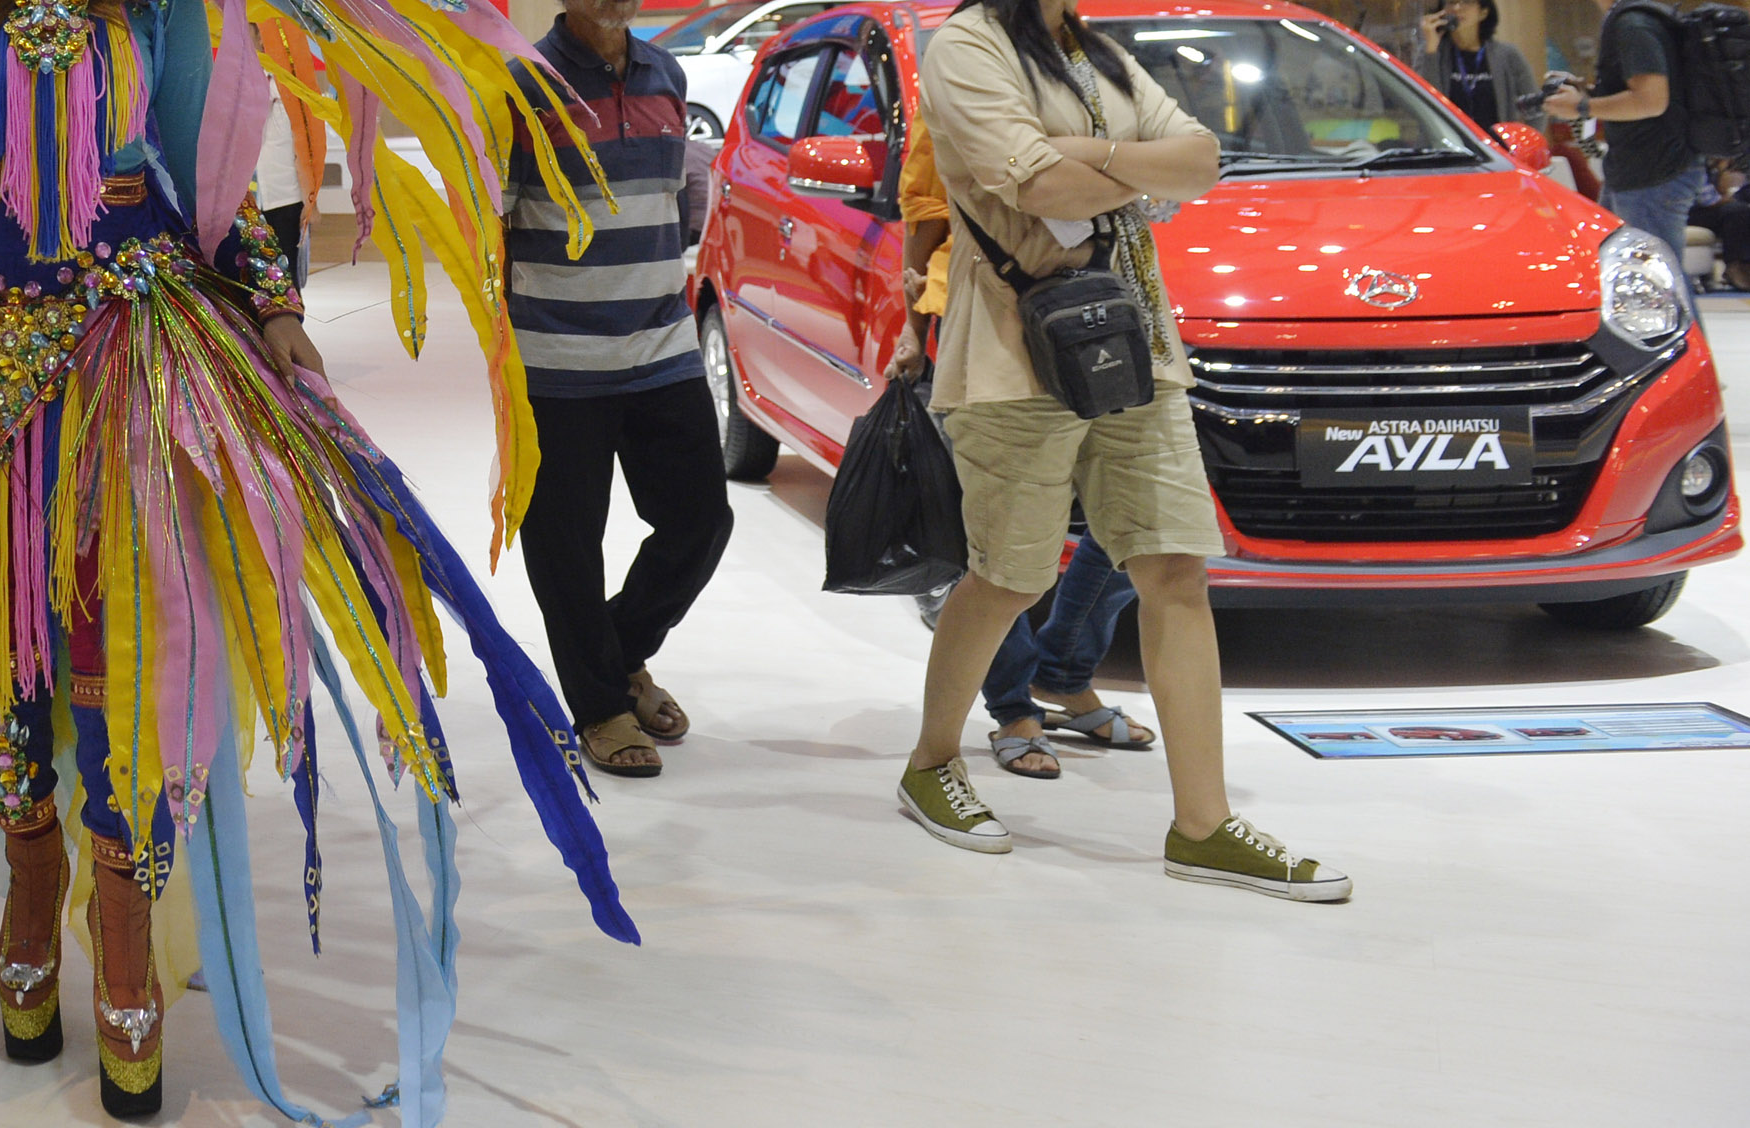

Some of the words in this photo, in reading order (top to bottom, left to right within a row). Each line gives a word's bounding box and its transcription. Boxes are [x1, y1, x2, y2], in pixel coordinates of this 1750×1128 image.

[1325, 426, 1363, 441] New
[1368, 420, 1422, 434] ASTRA
[1425, 419, 1499, 433] DAIHATSU
[1335, 434, 1510, 472] AYLA
